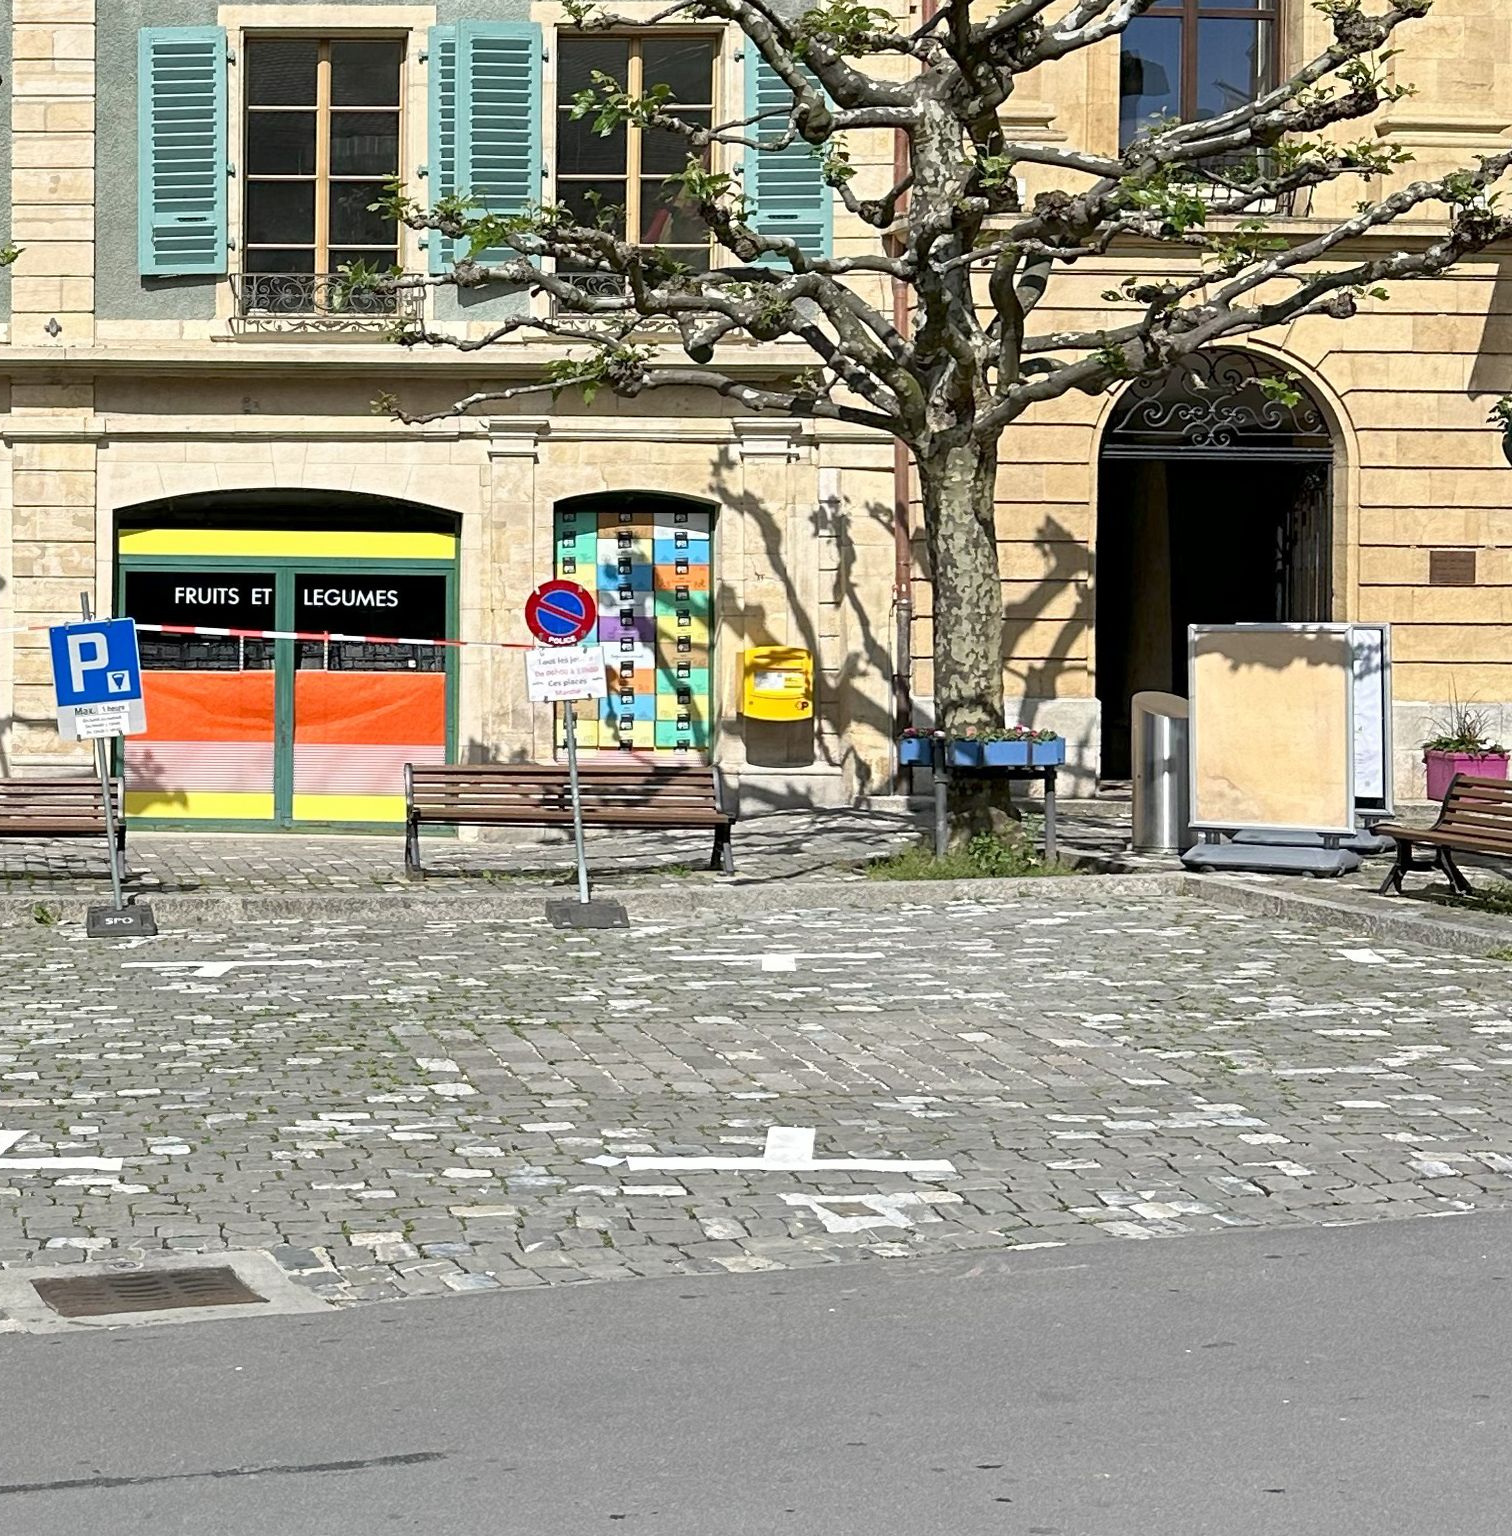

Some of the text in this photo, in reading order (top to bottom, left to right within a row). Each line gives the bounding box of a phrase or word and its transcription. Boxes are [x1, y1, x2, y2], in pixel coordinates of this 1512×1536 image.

[174, 586, 399, 607] FRUITS ET LEGUMES
[548, 635, 577, 644] POLICE
[67, 632, 109, 693] P
[563, 678, 588, 687] places
